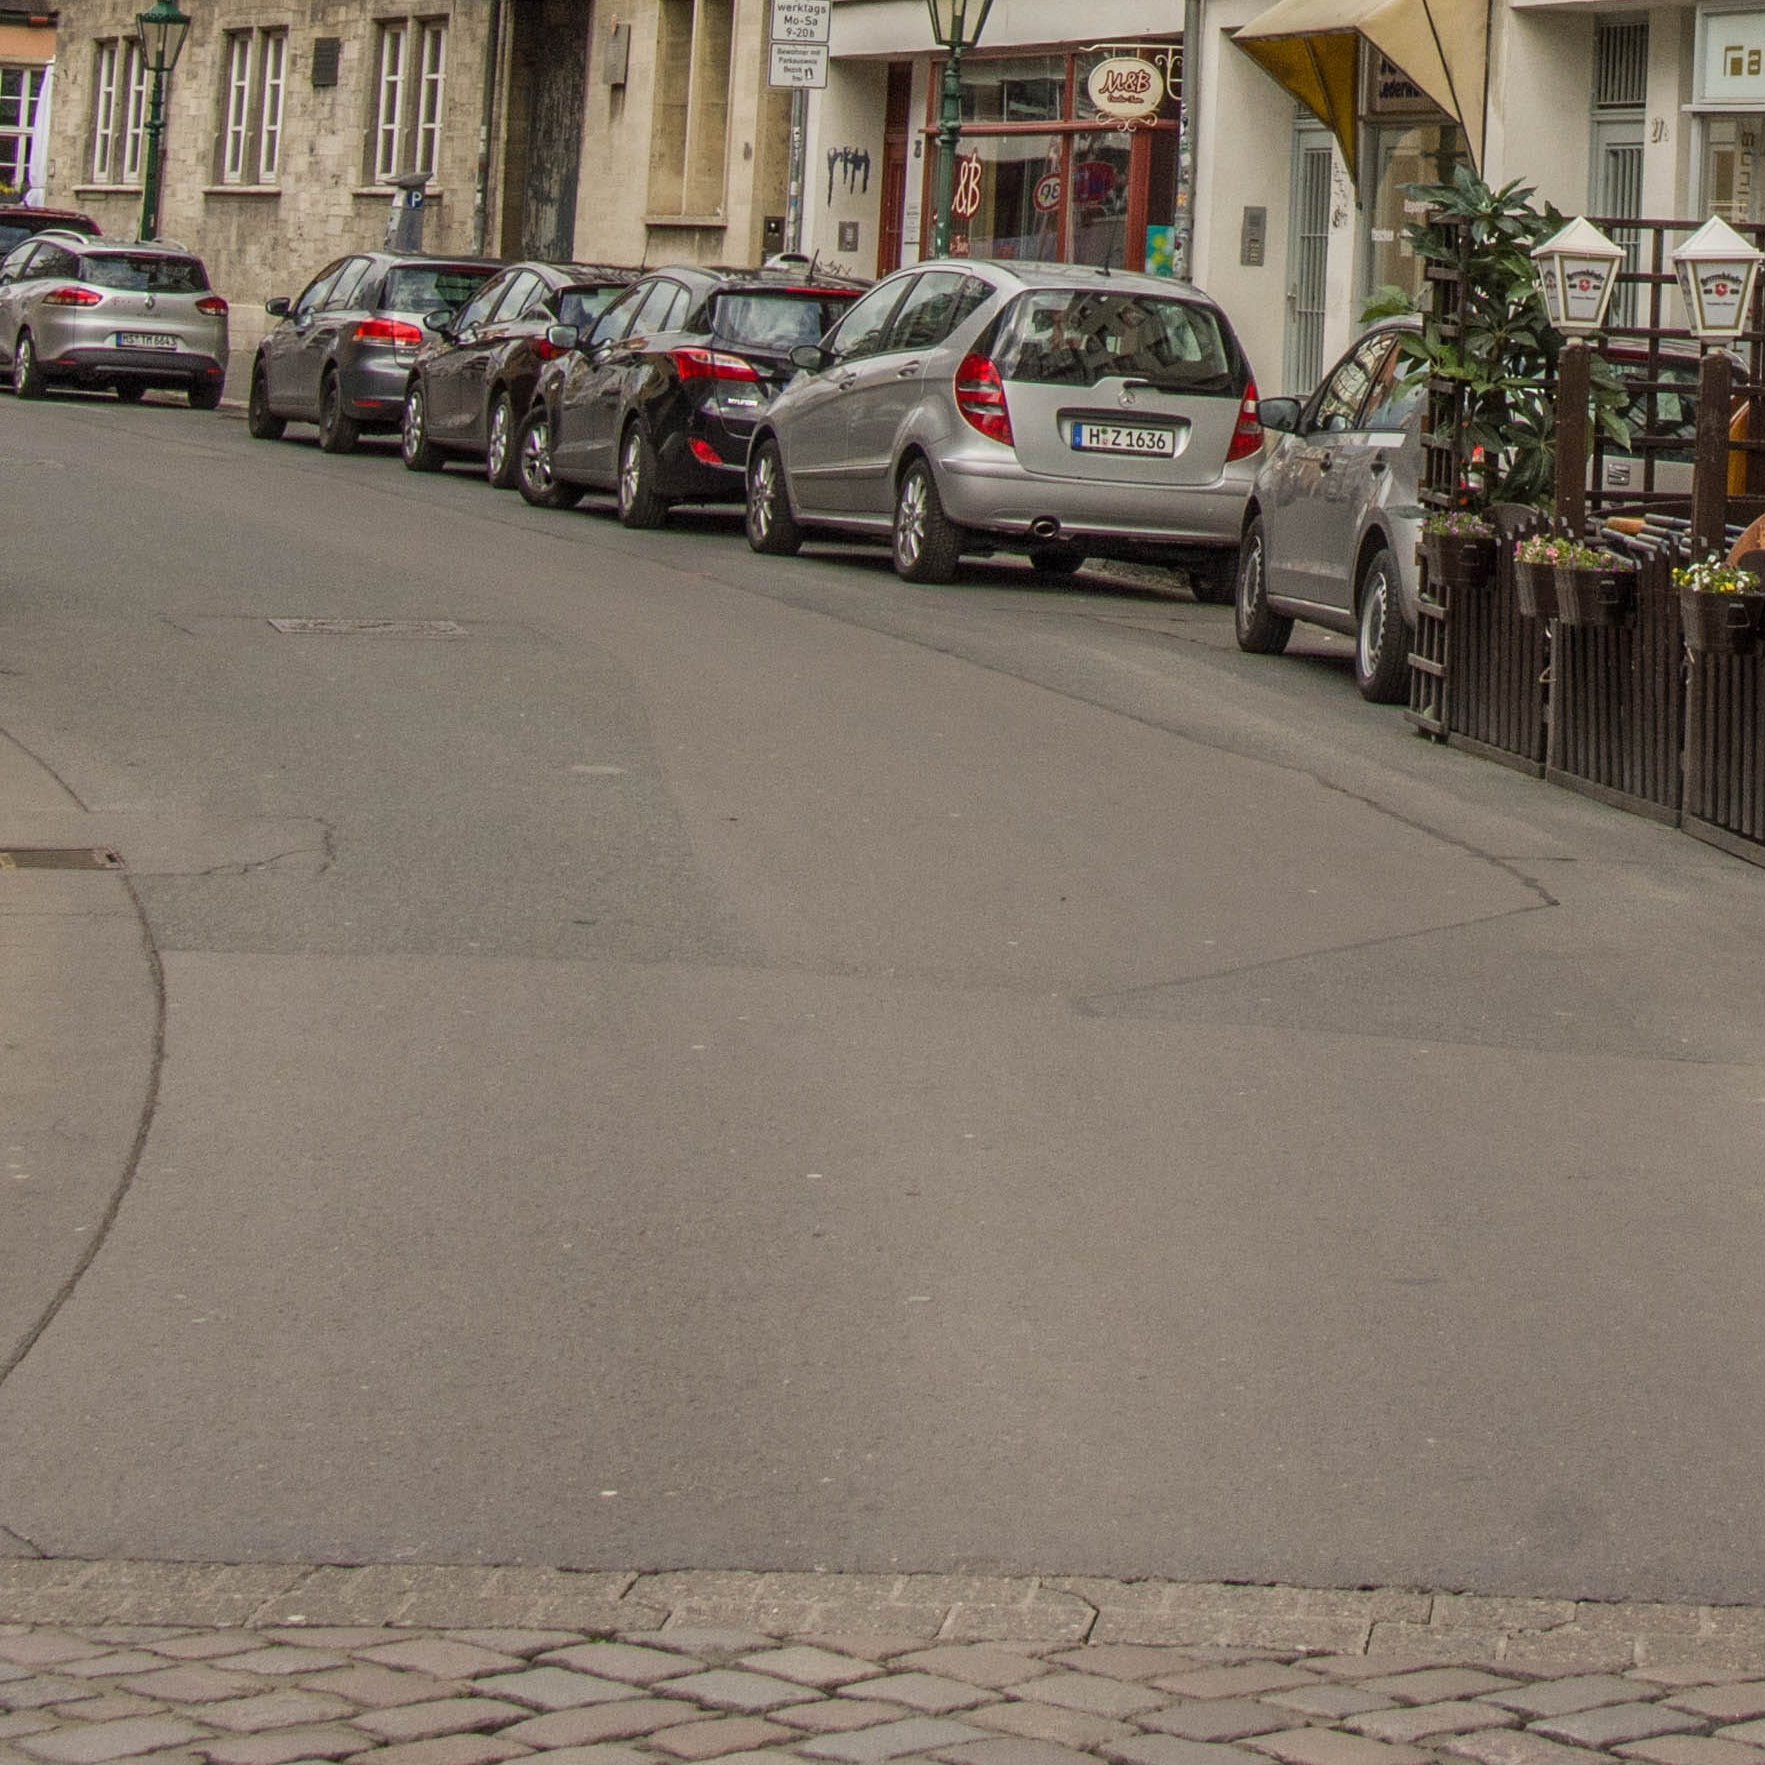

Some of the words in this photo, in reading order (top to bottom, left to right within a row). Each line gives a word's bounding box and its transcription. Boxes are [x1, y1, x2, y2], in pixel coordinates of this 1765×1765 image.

[777, 3, 827, 15] werktags
[1098, 69, 1151, 93] M&B
[1090, 428, 1100, 445] H
[1111, 429, 1121, 446] Z
[1125, 431, 1166, 450] 1636
